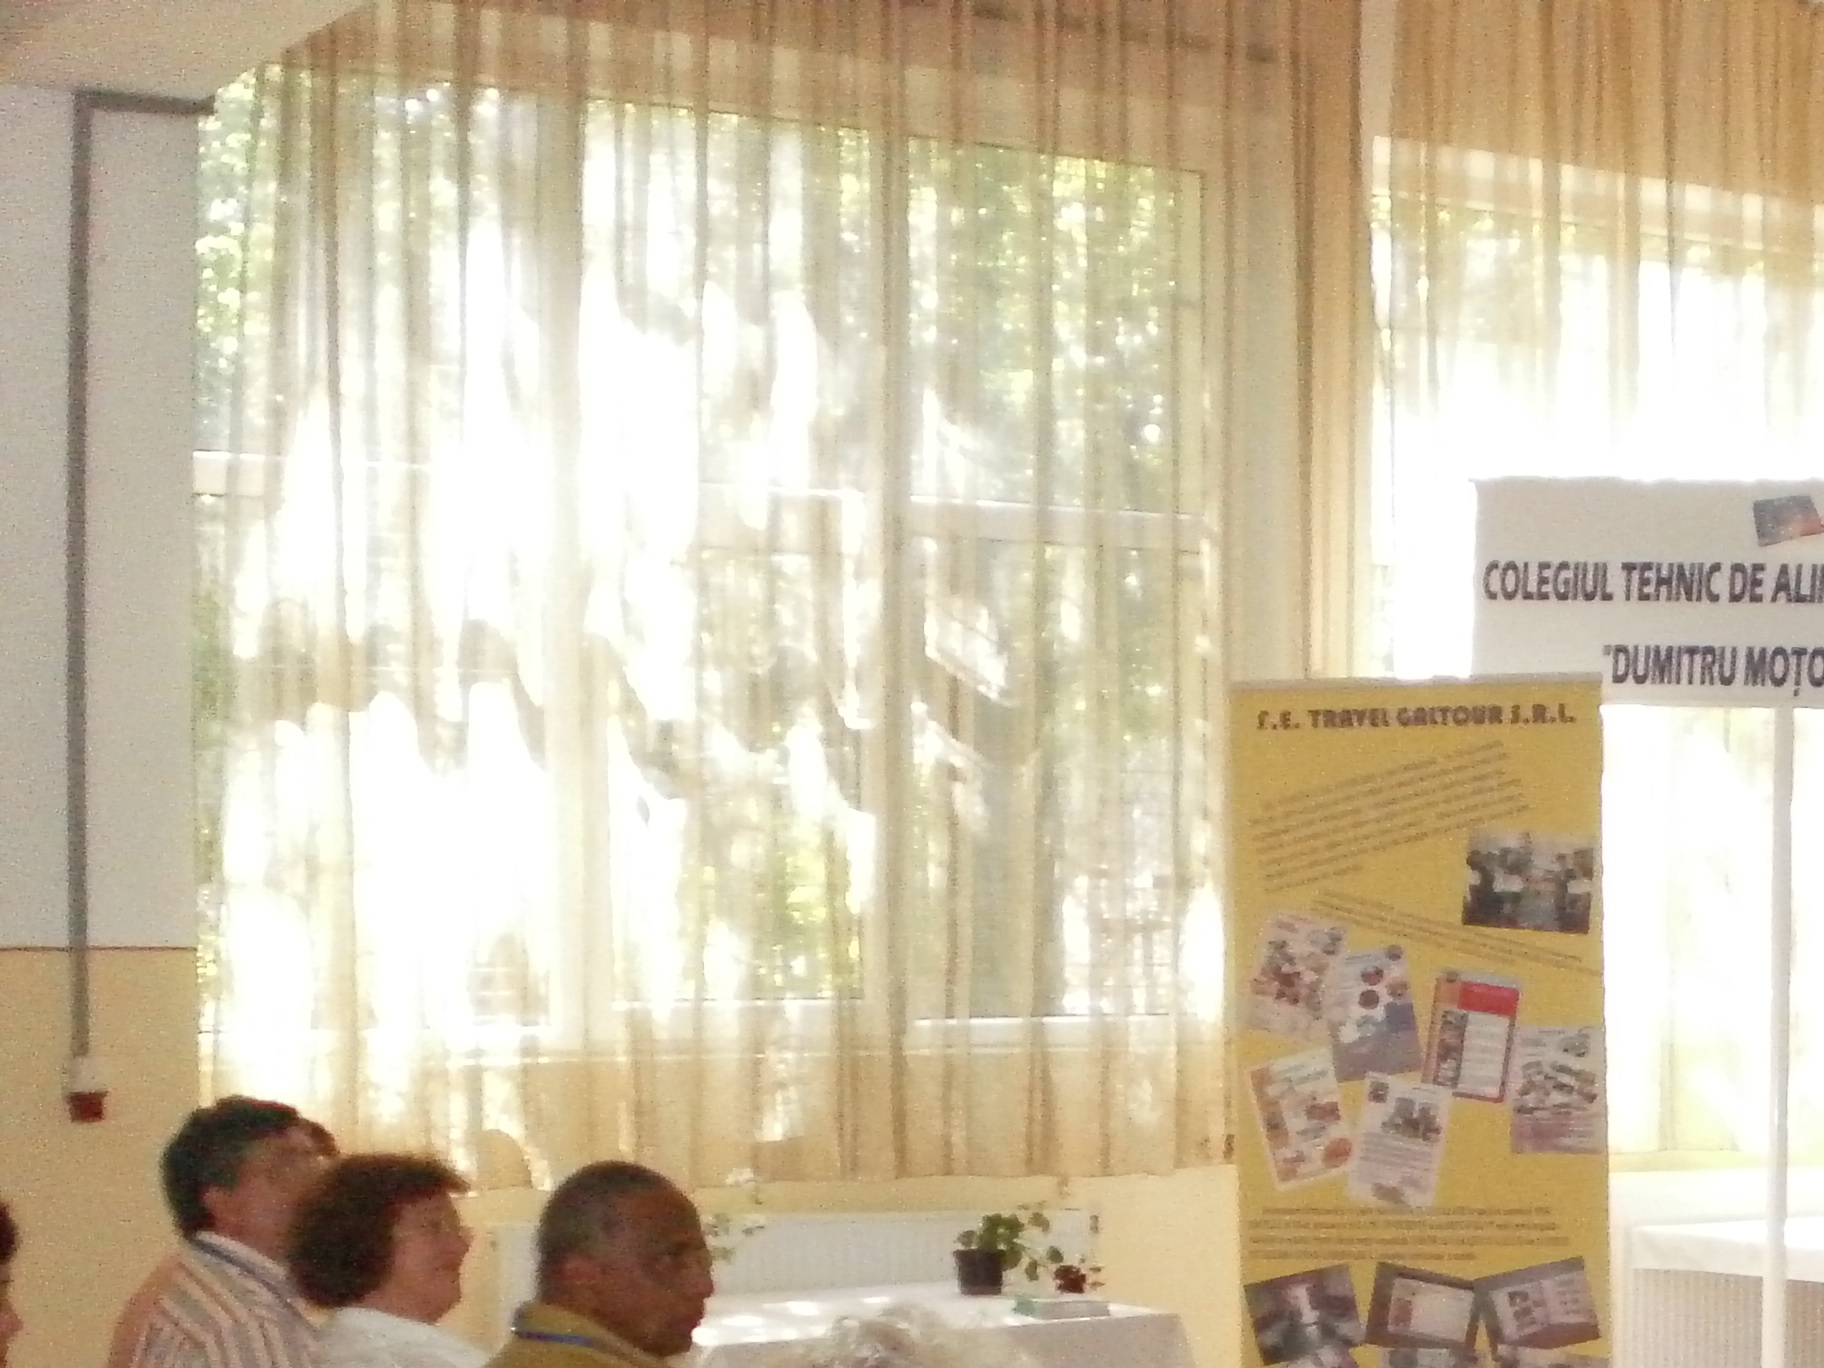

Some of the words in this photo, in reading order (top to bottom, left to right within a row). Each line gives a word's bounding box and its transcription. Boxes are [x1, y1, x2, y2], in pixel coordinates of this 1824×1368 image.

[1483, 560, 1613, 601] COLEGIUL
[1621, 562, 1722, 602] TEHNIC
[1729, 562, 1766, 603] DE
[1603, 645, 1738, 686] "DUMITRU
